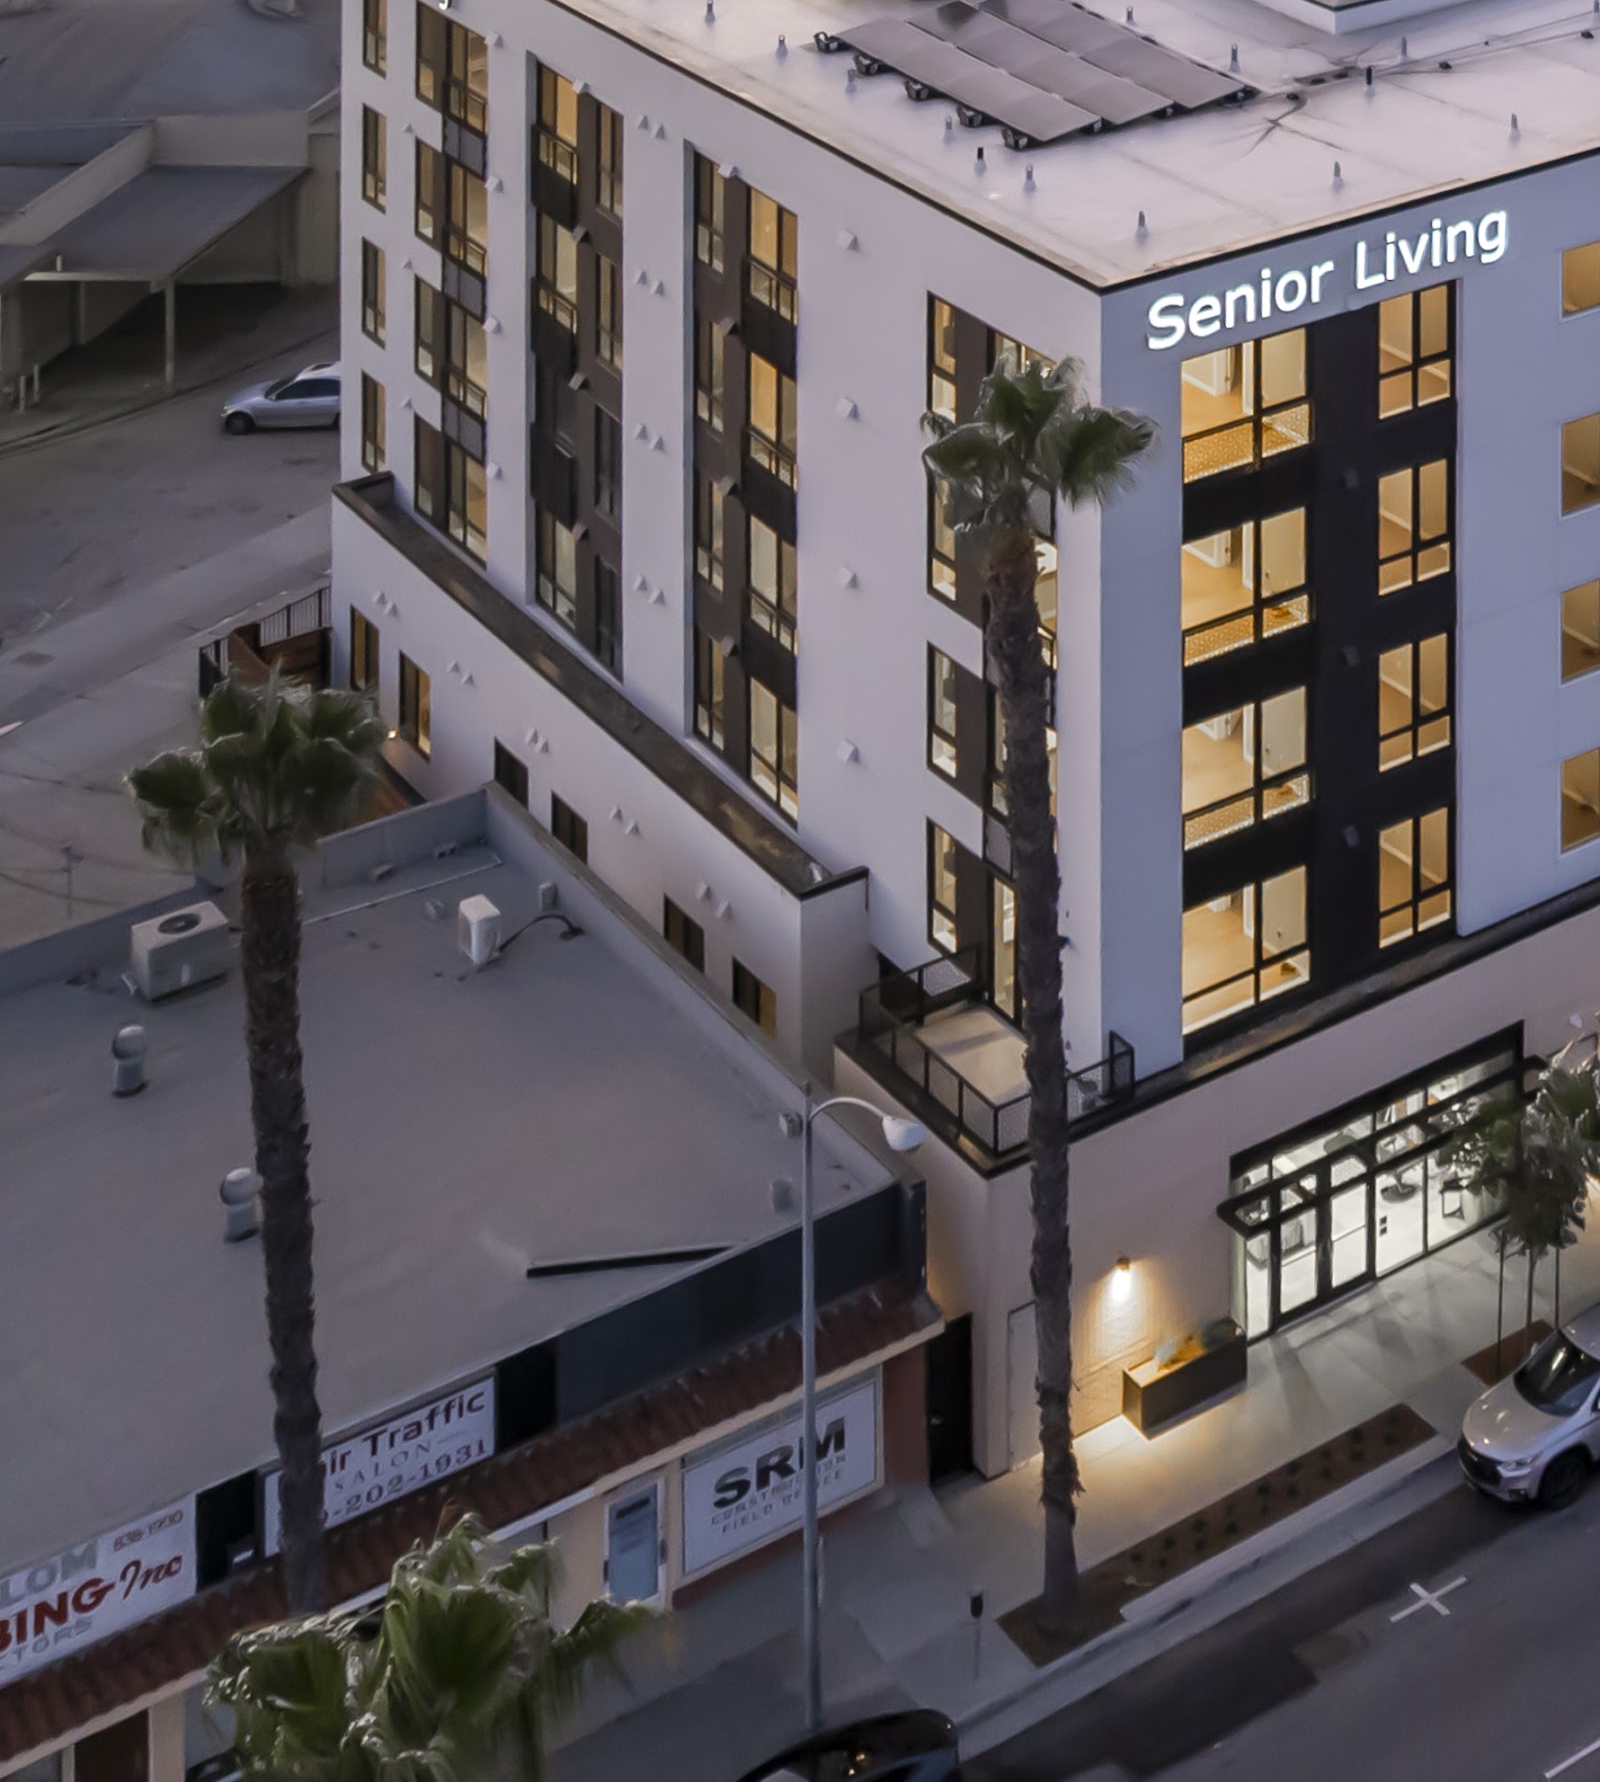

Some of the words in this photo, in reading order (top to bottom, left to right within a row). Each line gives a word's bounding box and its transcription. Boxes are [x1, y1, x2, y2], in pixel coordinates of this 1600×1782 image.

[1147, 260, 1335, 351] Senior
[1356, 209, 1508, 290] Living
[361, 1391, 486, 1457] Traffic
[323, 1438, 487, 1524] -202-1931
[333, 1440, 432, 1492] SALON
[712, 1416, 846, 1509] SRM
[721, 1503, 775, 1534] FIELD
[119, 1555, 184, 1600] Inc
[0, 1617, 93, 1662] TORS
